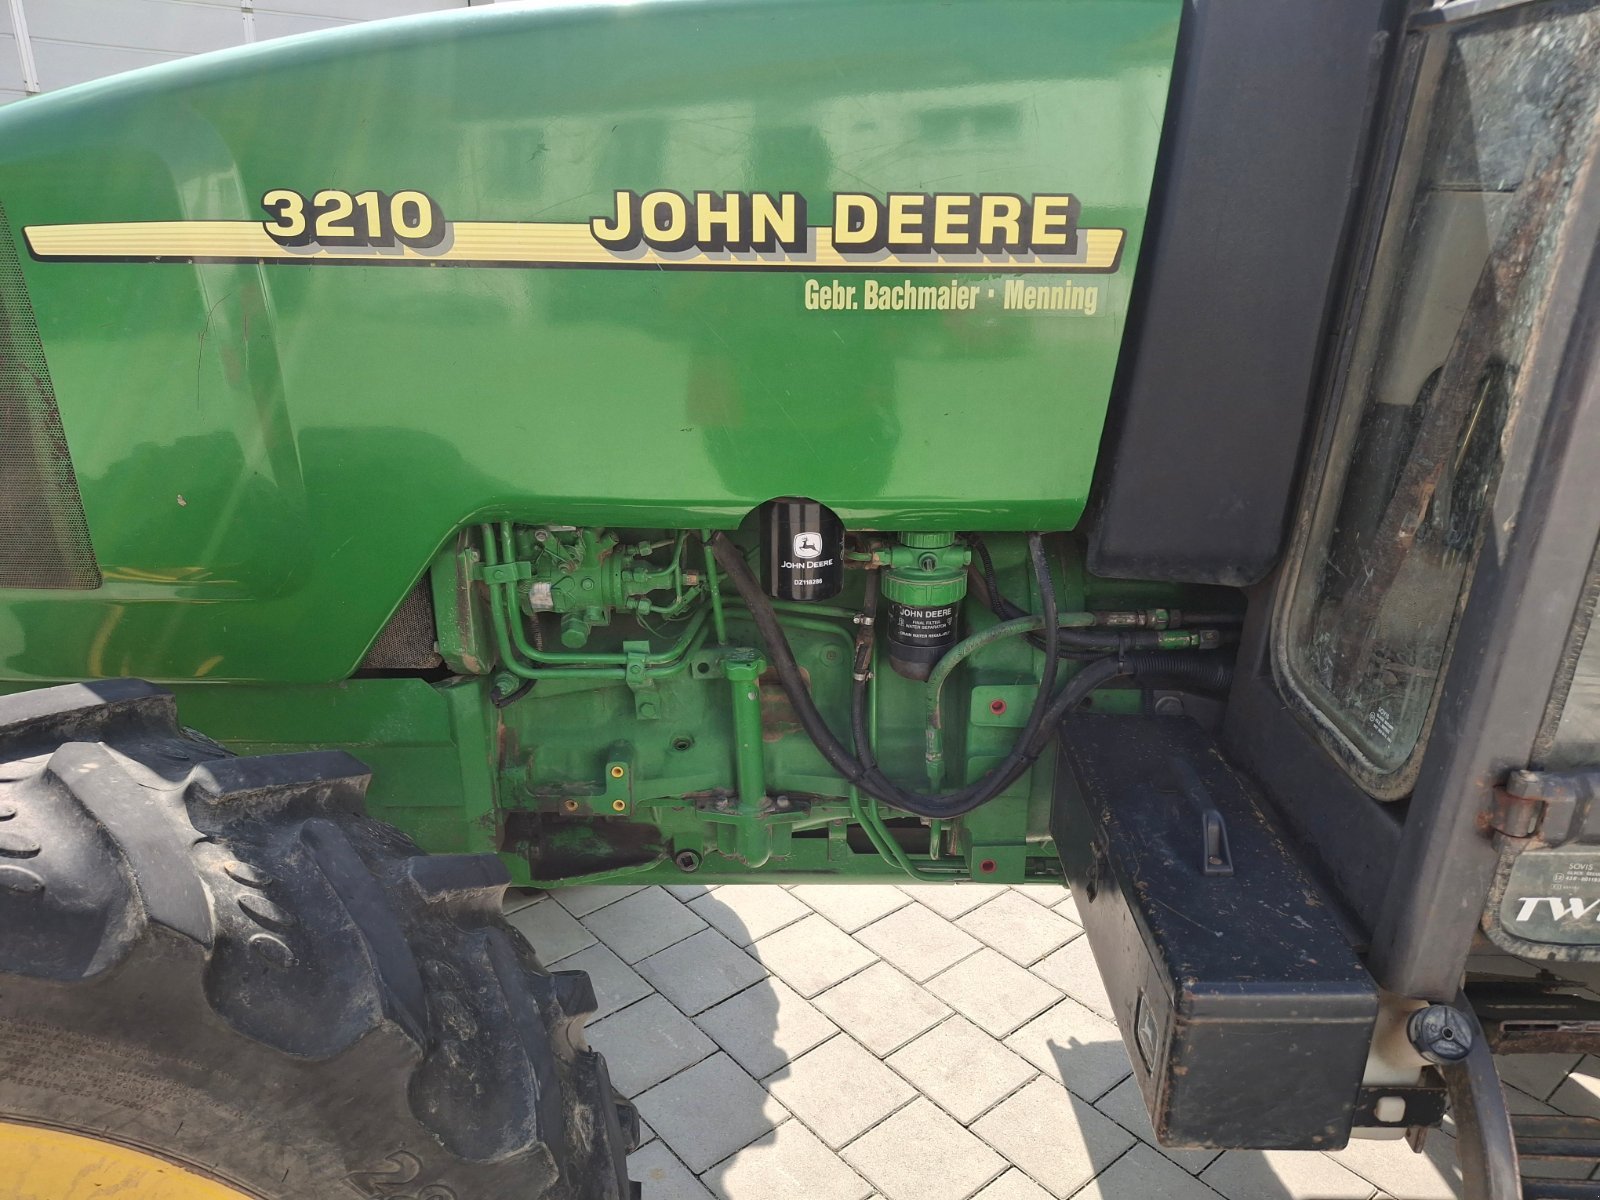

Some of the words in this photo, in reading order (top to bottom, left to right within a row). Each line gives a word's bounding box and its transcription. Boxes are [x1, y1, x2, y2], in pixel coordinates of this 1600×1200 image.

[262, 189, 434, 240] 3210
[592, 191, 796, 242] JOHN
[834, 194, 1070, 246] DEERE
[804, 279, 858, 310] Gebr.
[864, 279, 980, 310] Bachmaier
[1003, 279, 1099, 316] Menning
[780, 560, 805, 569] JOHN
[806, 558, 834, 569] DEERE
[899, 608, 923, 618] JOHN
[925, 607, 952, 618] DEERE
